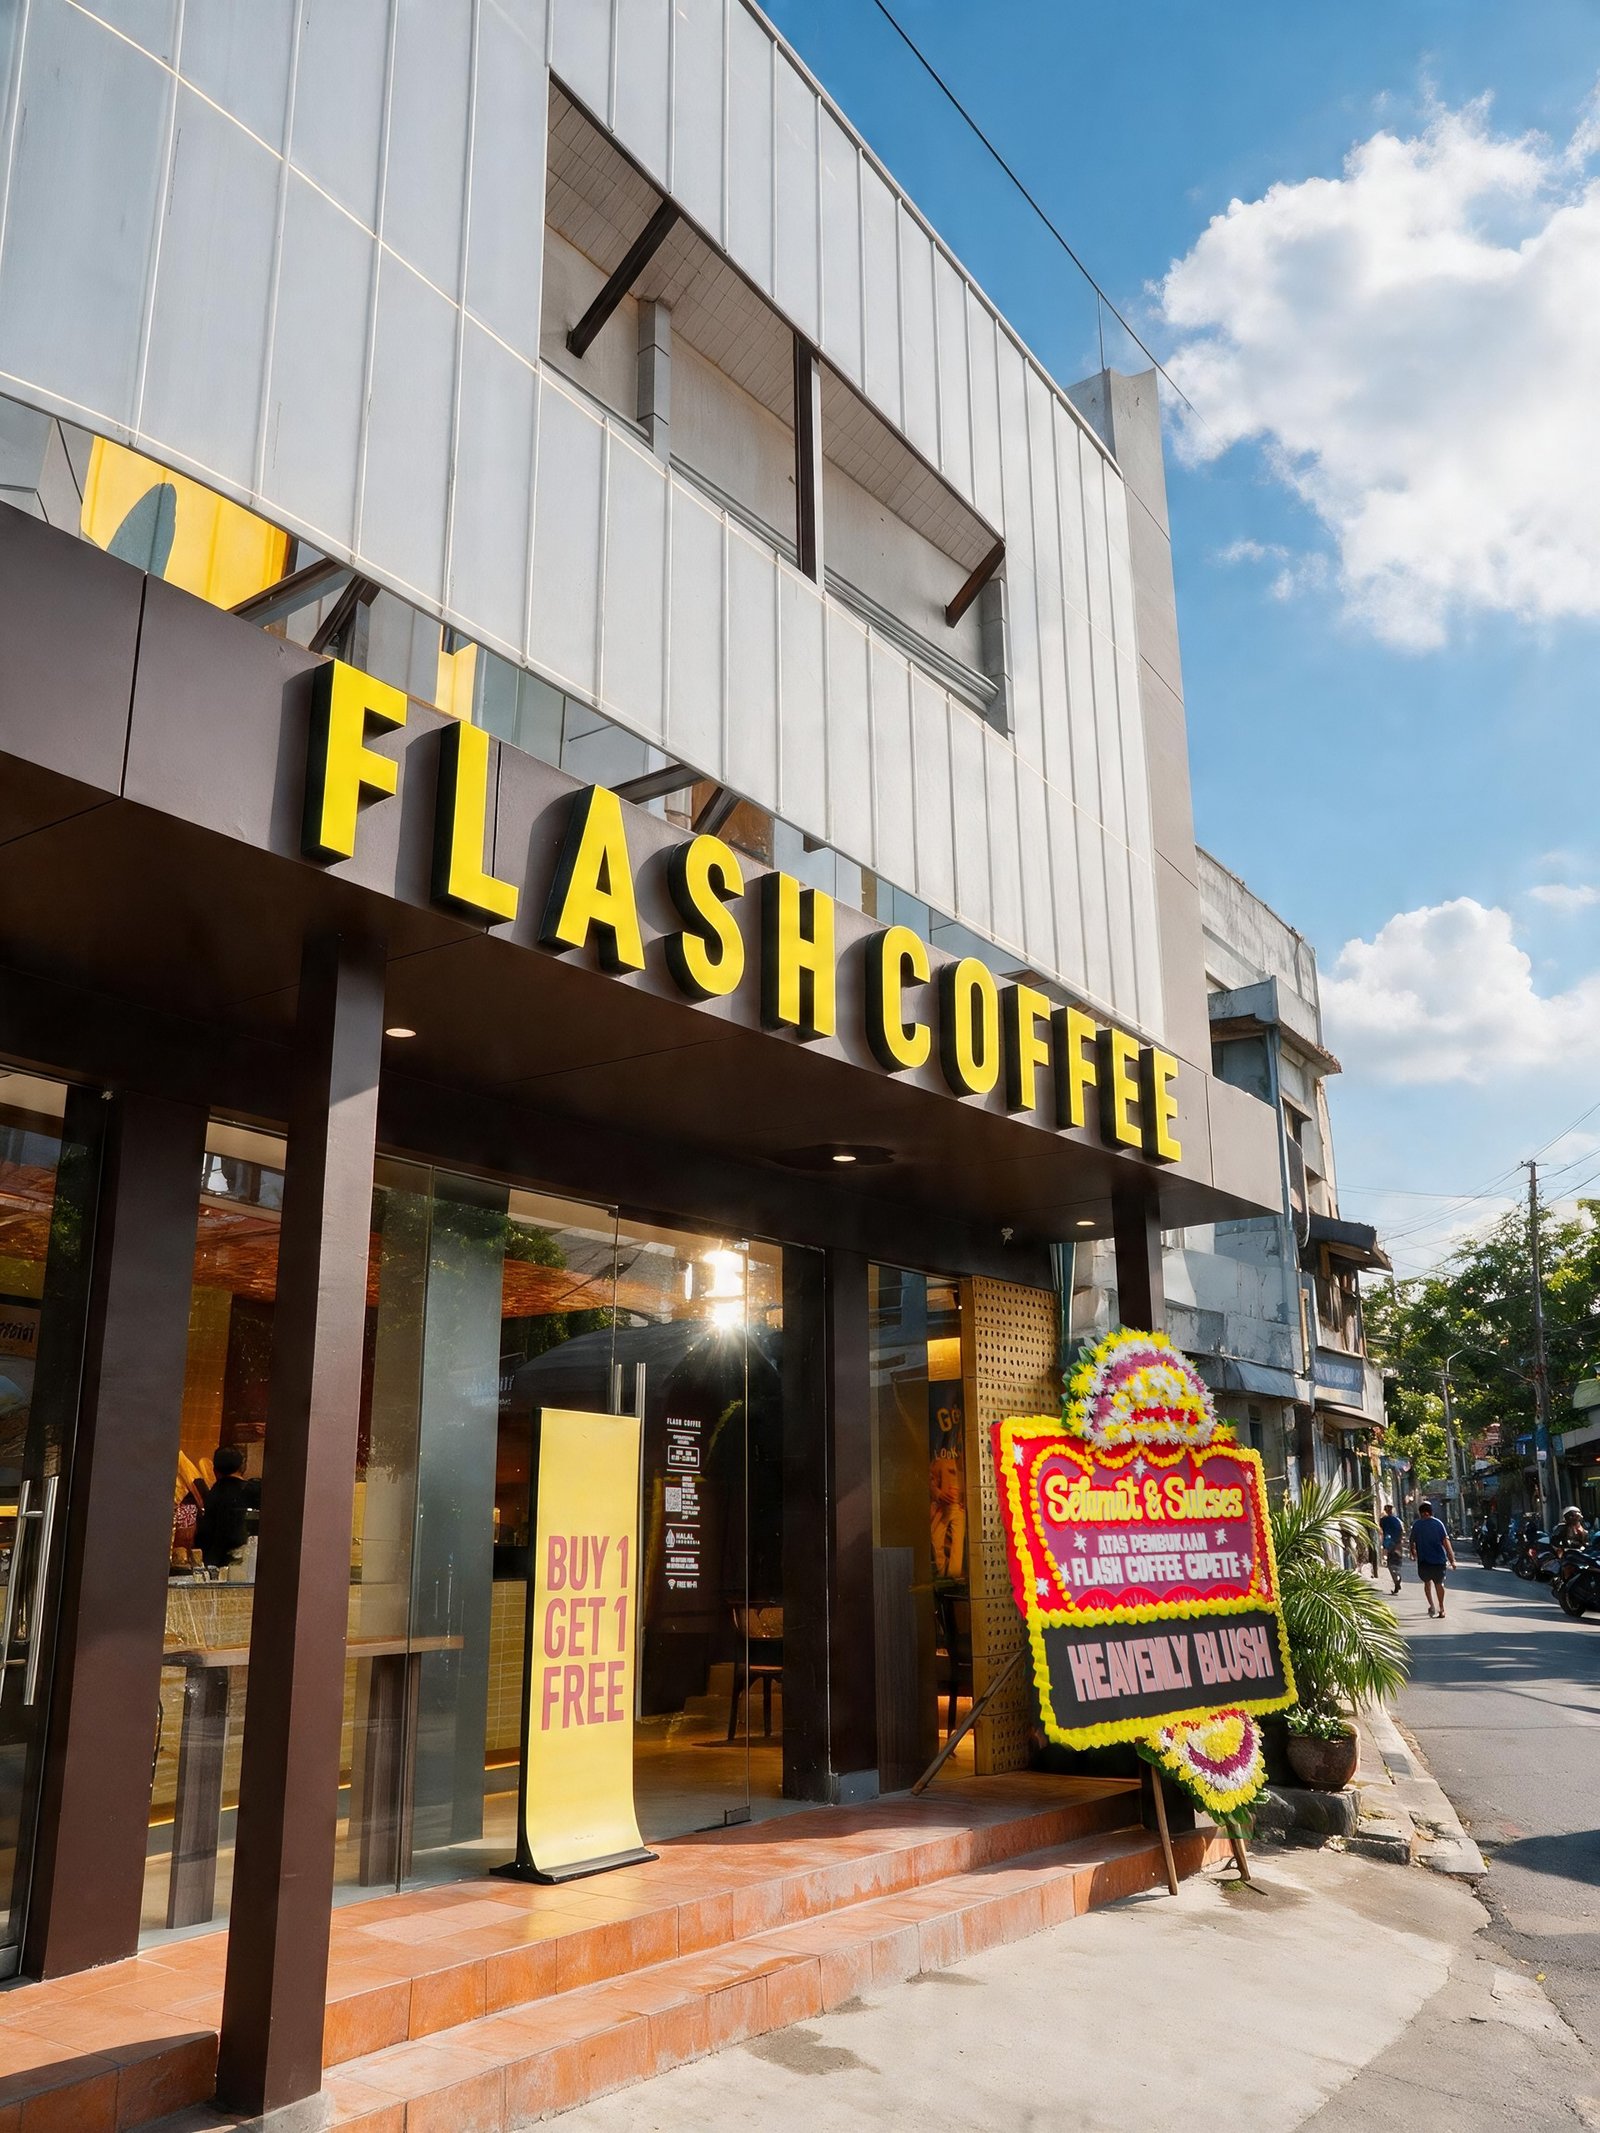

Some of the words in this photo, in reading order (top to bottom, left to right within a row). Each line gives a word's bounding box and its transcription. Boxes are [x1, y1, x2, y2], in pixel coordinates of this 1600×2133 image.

[303, 659, 837, 1038] FLASH
[866, 925, 1181, 1164] COFFEE
[667, 1417, 682, 1426] FLASH
[684, 1419, 701, 1428] COFFEE
[1144, 1479, 1166, 1520] &
[1164, 1475, 1245, 1519] Sukses
[547, 1535, 610, 1591] BUY
[616, 1535, 629, 1589] 1
[1071, 1555, 1125, 1587] FLASH
[1124, 1553, 1185, 1583] COFFEE
[1098, 1534, 1129, 1555] ATAS
[1130, 1532, 1208, 1554] PEMBUKAAN
[544, 1597, 606, 1659] GET
[613, 1595, 628, 1652] 1
[1067, 1635, 1193, 1702] HEAVENLY
[1193, 1626, 1275, 1686] BLUSH
[541, 1660, 625, 1731] FREE
